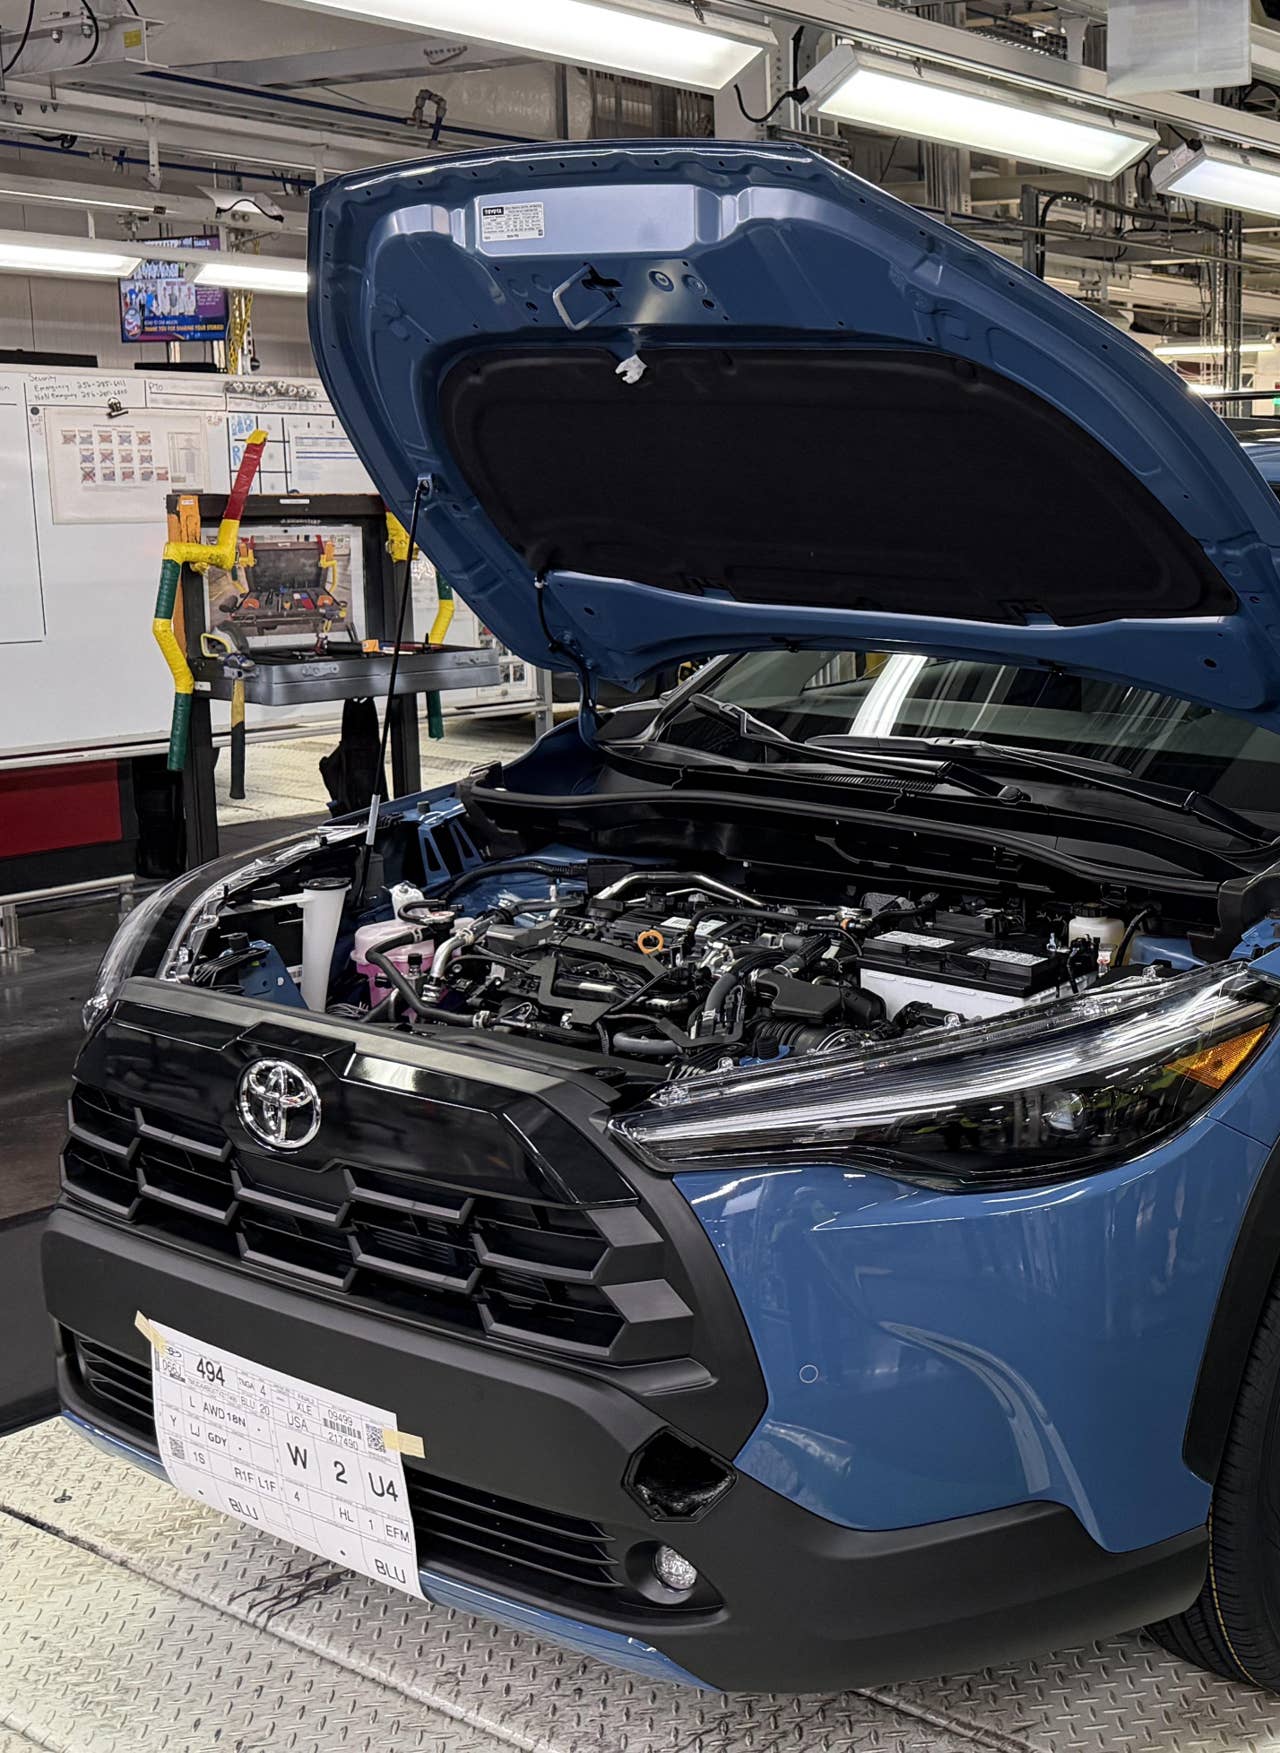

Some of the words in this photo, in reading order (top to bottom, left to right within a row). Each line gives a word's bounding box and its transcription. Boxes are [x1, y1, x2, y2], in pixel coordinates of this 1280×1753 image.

[196, 1358, 225, 1387] 494
[260, 1385, 266, 1396] 4
[189, 1396, 196, 1408] L
[296, 1401, 312, 1416] XLE
[202, 1402, 226, 1420] AWD
[226, 1412, 247, 1427] 18N
[170, 1414, 177, 1427] Y
[286, 1411, 309, 1432] USA
[207, 1432, 227, 1447] GDY
[286, 1442, 308, 1470] W
[233, 1466, 254, 1483] R1F
[333, 1460, 348, 1485] 2
[257, 1475, 277, 1492] L1F
[368, 1471, 399, 1503] U4
[294, 1491, 300, 1502] 4
[228, 1497, 259, 1520] BLU
[339, 1506, 354, 1523] HL
[368, 1519, 374, 1530] 1
[385, 1524, 410, 1544] EFM
[374, 1558, 406, 1584] BLU
